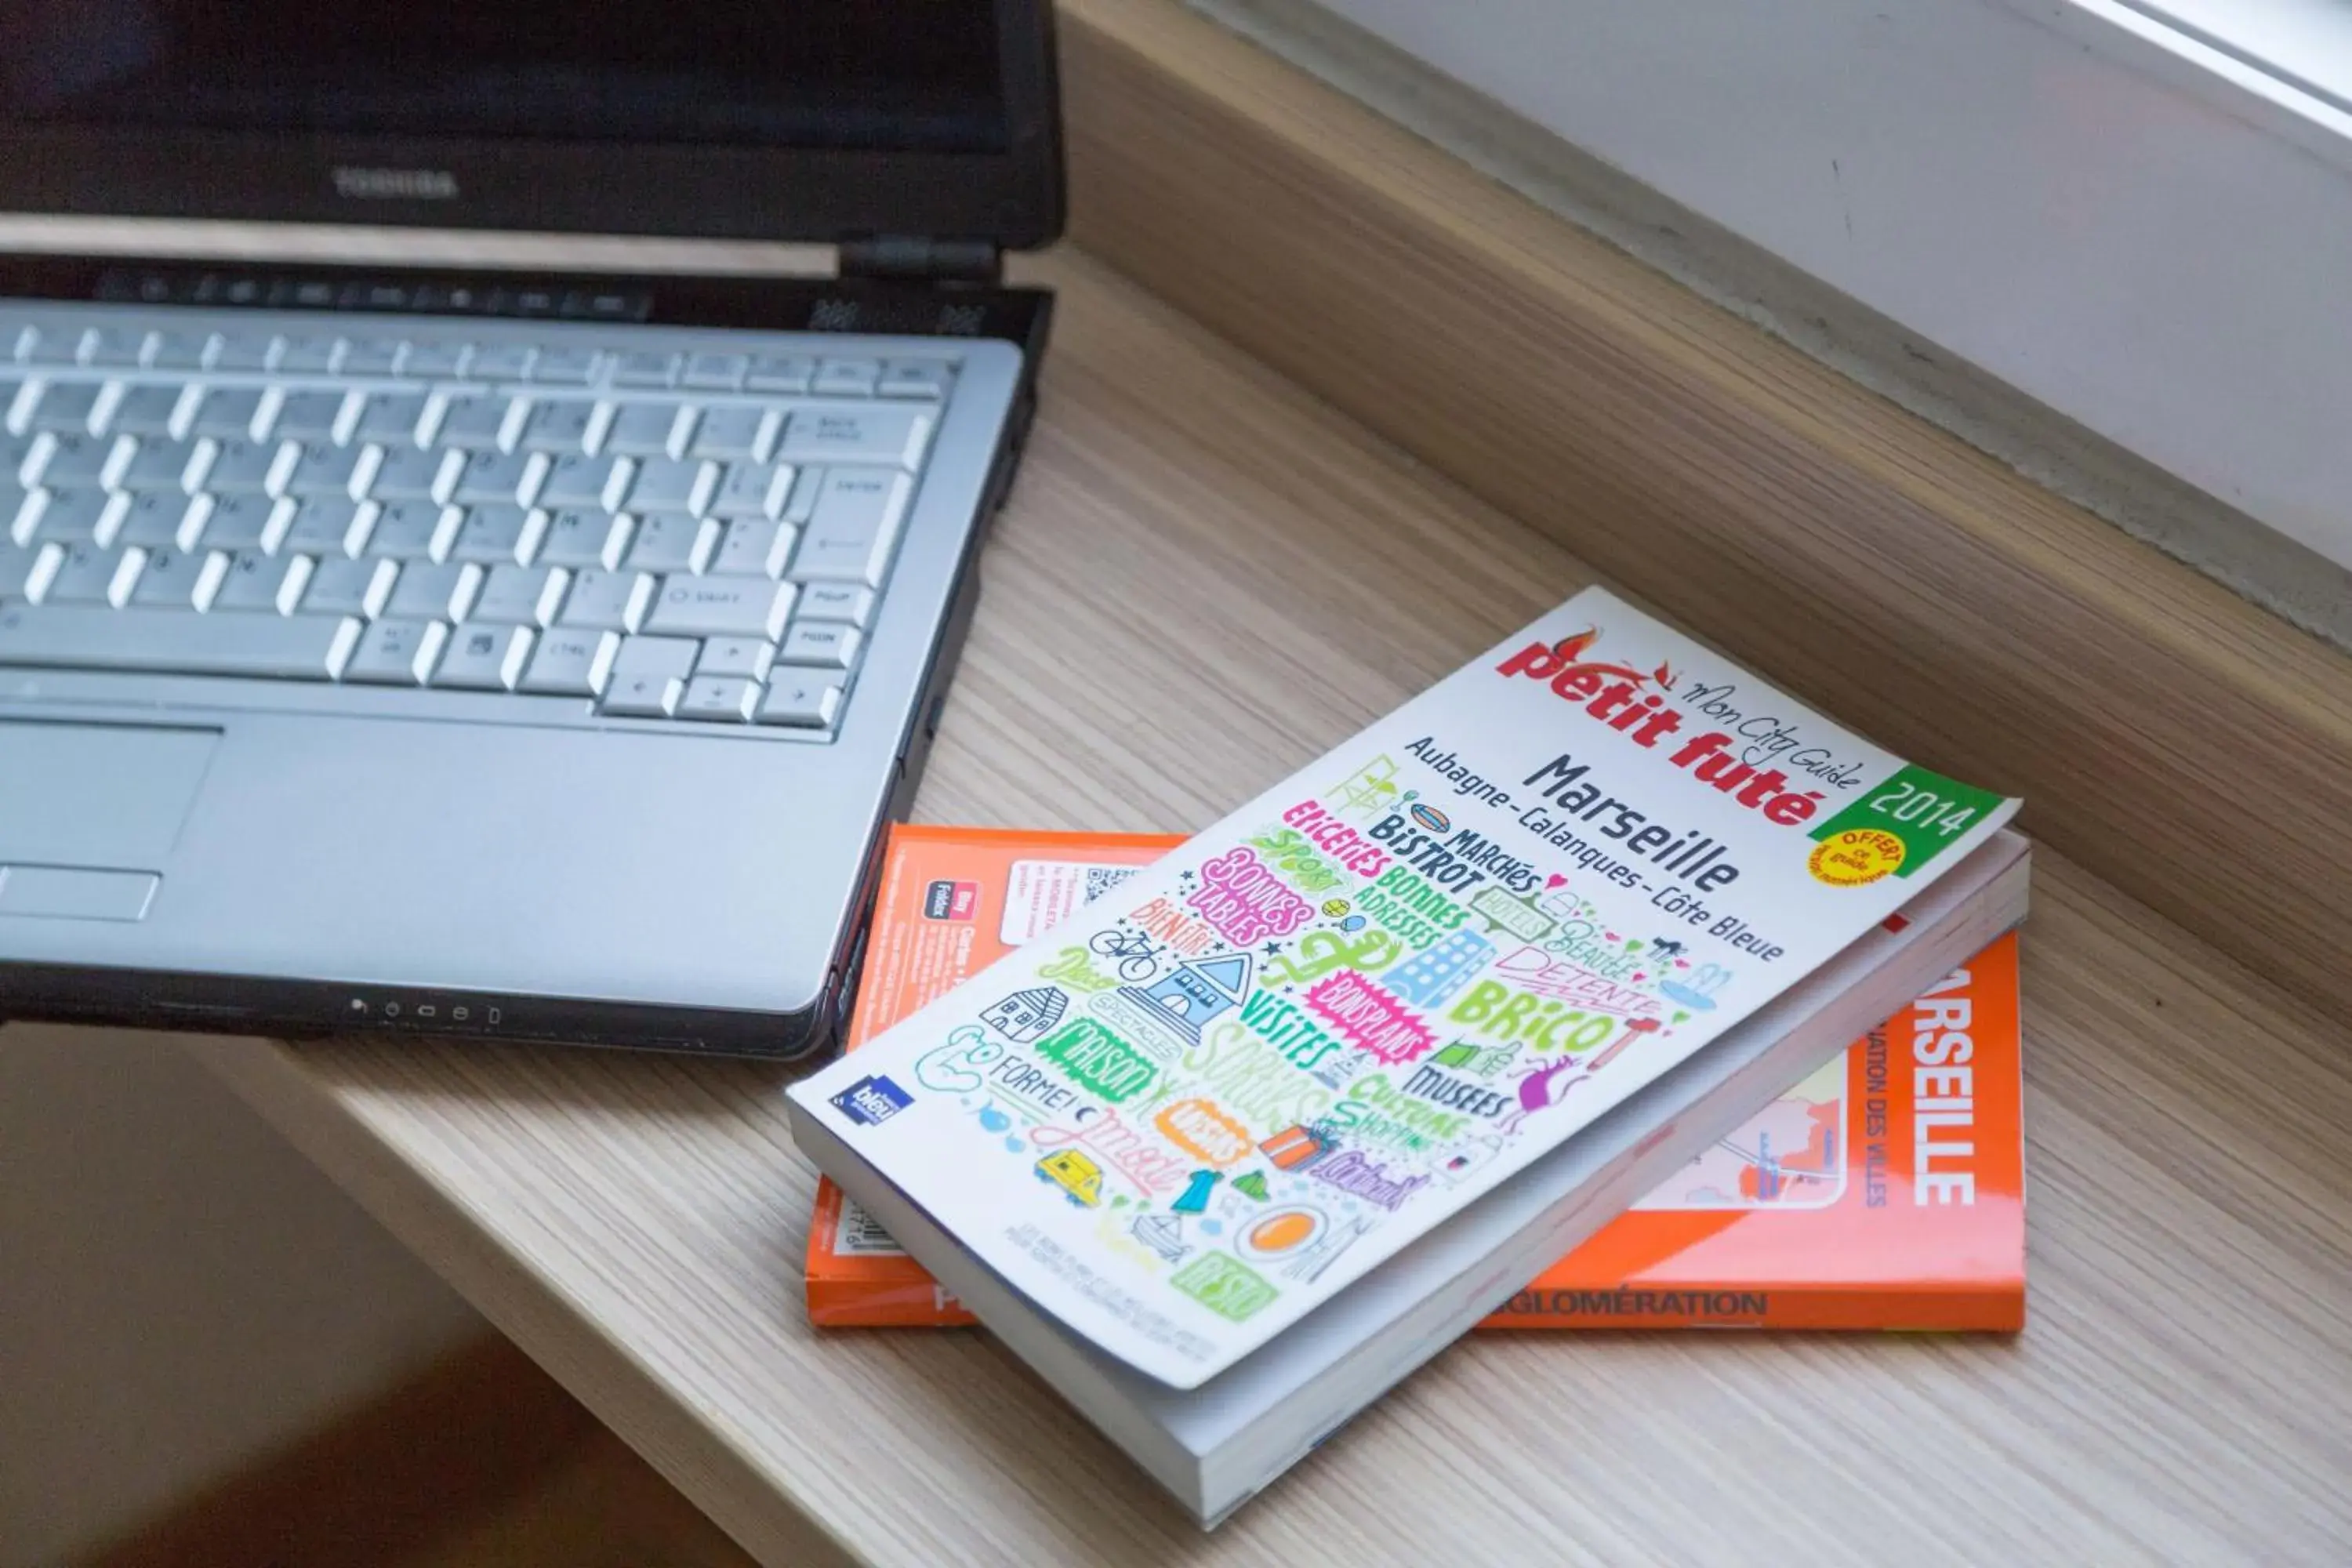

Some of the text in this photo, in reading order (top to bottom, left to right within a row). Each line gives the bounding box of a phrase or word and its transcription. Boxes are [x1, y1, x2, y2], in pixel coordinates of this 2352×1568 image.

[1494, 637, 1831, 828] petit futé
[1682, 679, 1864, 792] Mon City Guide
[1521, 753, 1739, 894] Marseille
[1869, 780, 1979, 838] 2014
[1264, 829, 1343, 890] SPORT
[1406, 739, 1510, 809] Aubagne
[1518, 806, 1639, 891] Calanques
[1651, 884, 1711, 928] Côte
[1709, 916, 1785, 964] Bleue
[1842, 831, 1901, 862] OFFERT
[1189, 884, 1269, 946] TABLES
[1202, 848, 1314, 935] BONNES
[1353, 886, 1444, 950] ADRESSES
[1376, 865, 1472, 931] BONNES
[989, 1055, 1076, 1112] FORME!
[1050, 1022, 1151, 1098] MAISON
[1866, 1098, 1887, 1138] DES
[1865, 1142, 1887, 1209] VILLES
